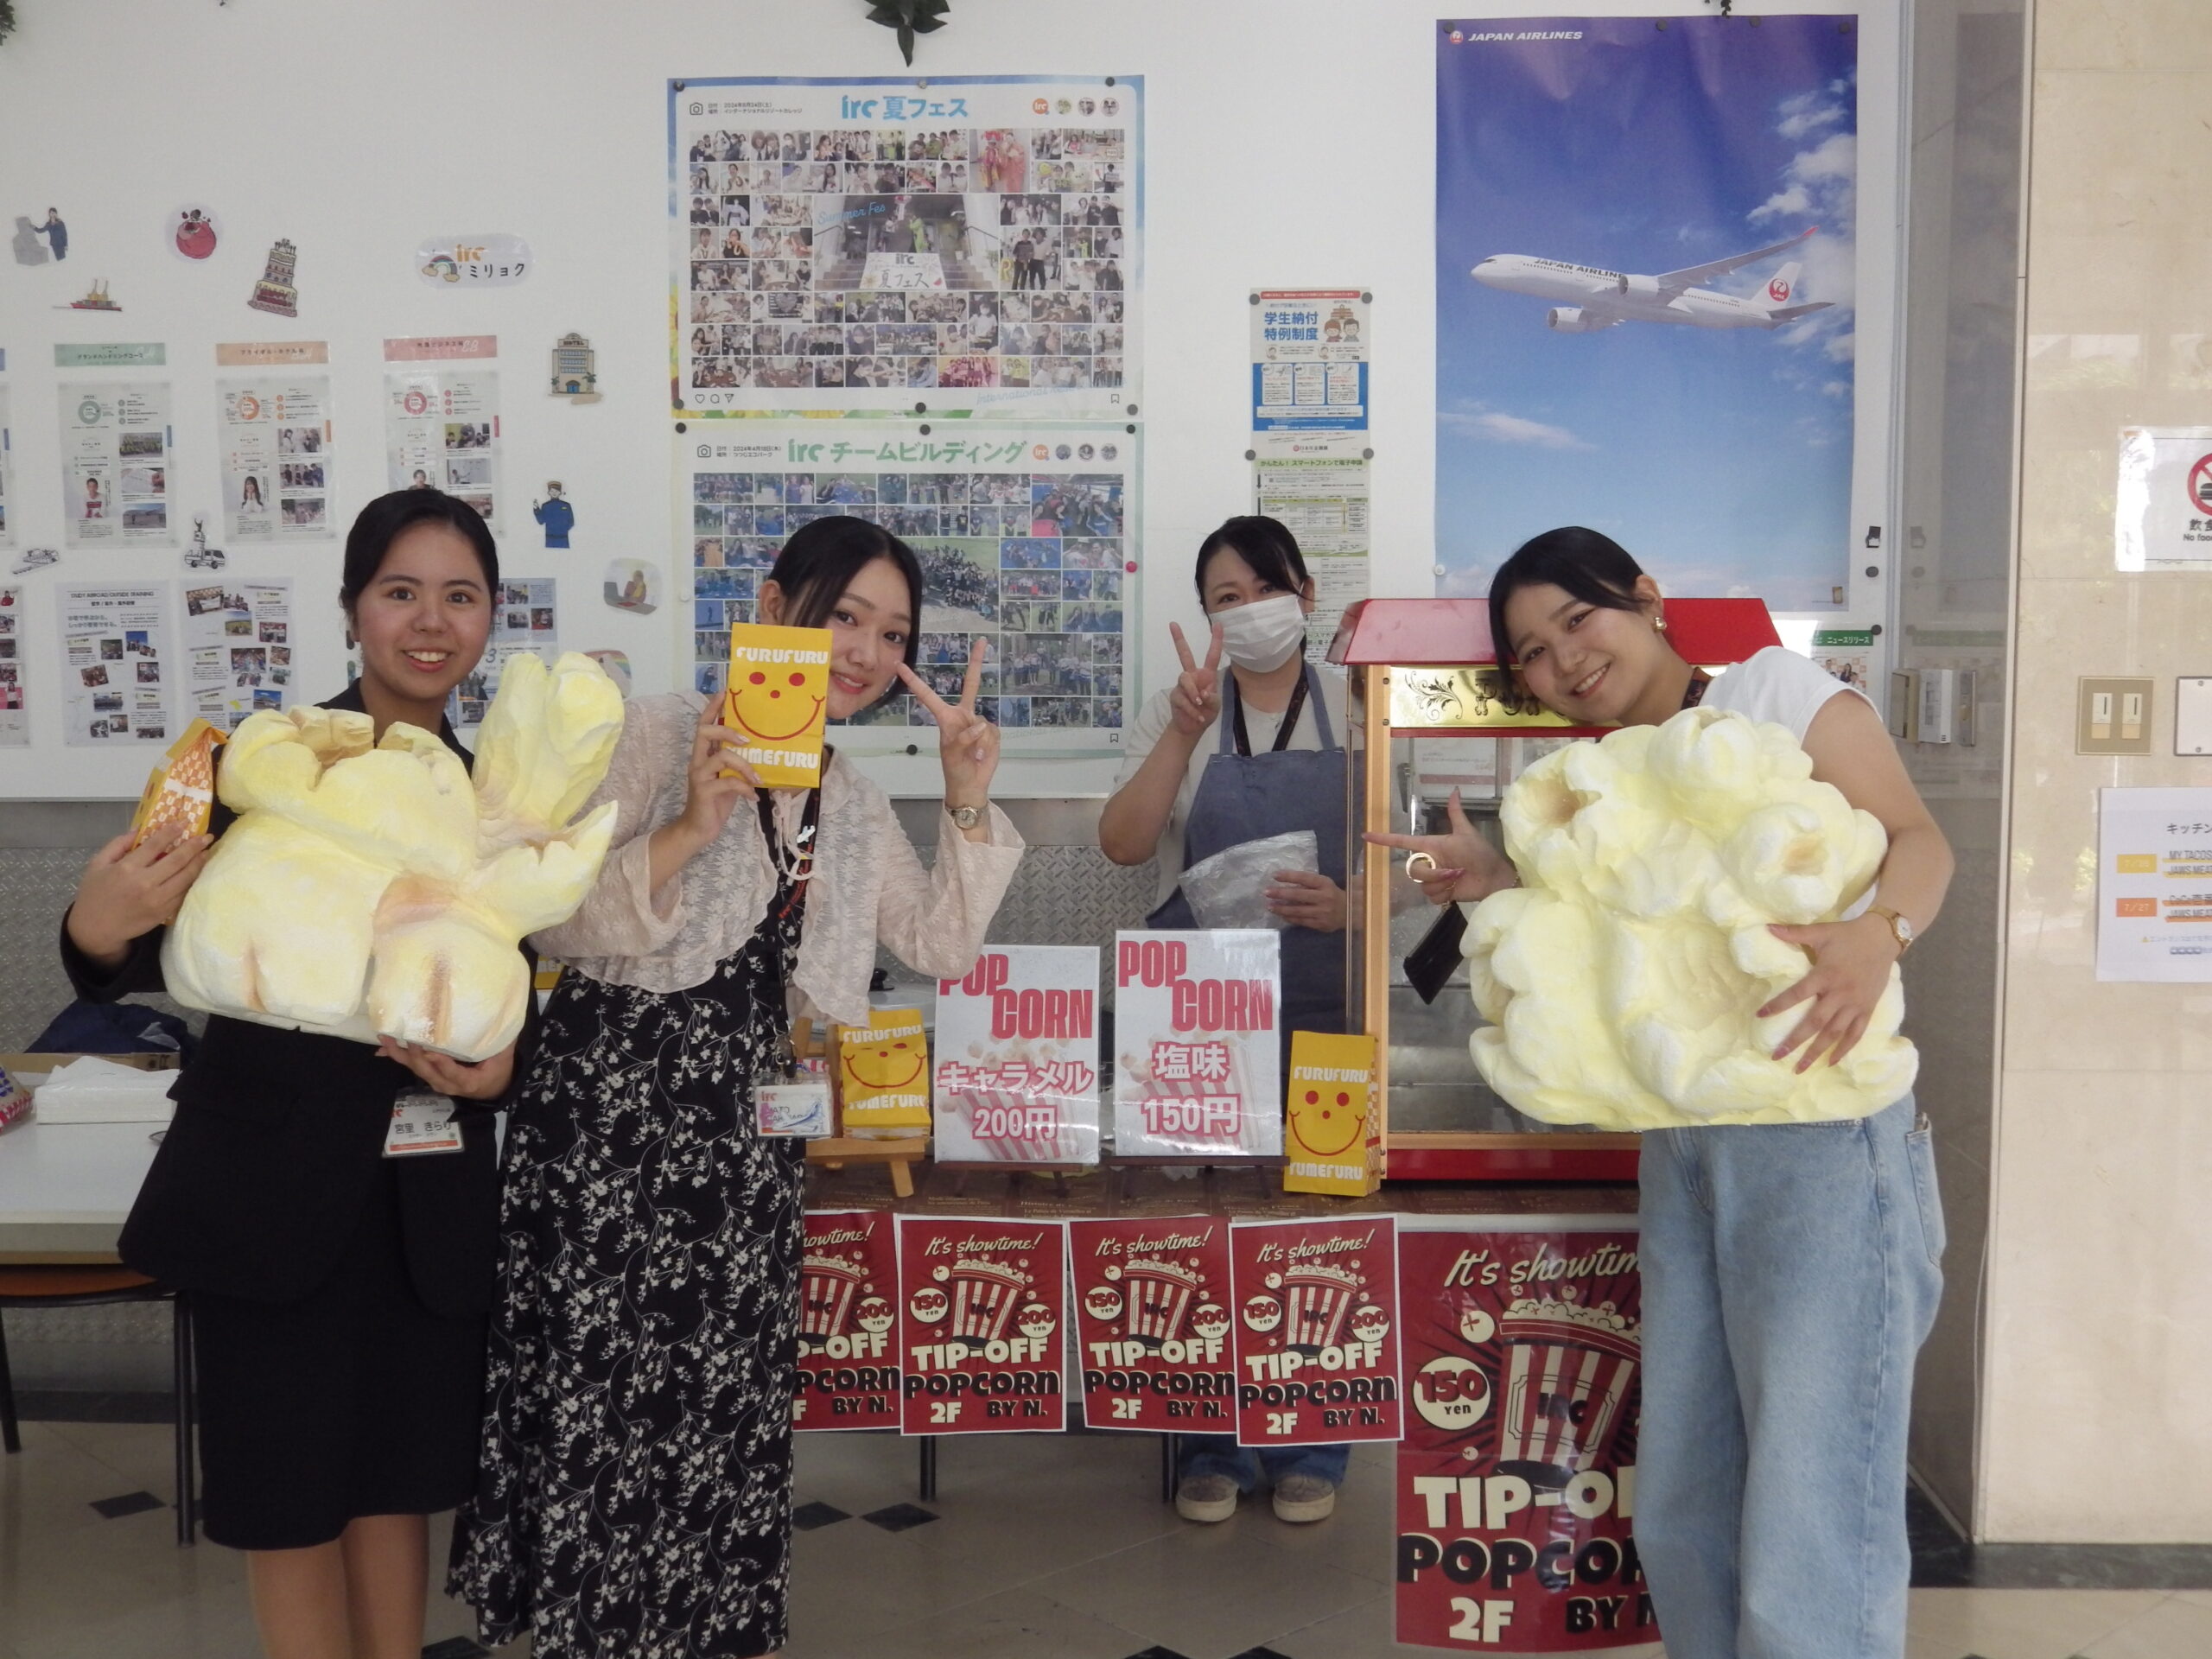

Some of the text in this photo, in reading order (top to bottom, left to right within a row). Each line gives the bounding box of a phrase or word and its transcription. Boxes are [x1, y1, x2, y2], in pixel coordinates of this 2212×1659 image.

[1516, 31, 1583, 40] AIRLINES
[842, 95, 969, 121] irc 夏フェス
[817, 201, 886, 225] Summer Fes
[456, 244, 485, 263] irc
[1534, 257, 1573, 270] JAPAN
[469, 263, 524, 278] ミリョク
[879, 270, 930, 289] 夏フェス
[1264, 312, 1319, 325] 学生納付
[1264, 327, 1319, 340] 特例制度
[788, 439, 1027, 463] irc チームビルディング
[736, 646, 828, 664] FURUFURU
[1118, 940, 1187, 988] POP
[991, 988, 1093, 1039] CORN
[1172, 978, 1273, 1032] CORN
[842, 1024, 922, 1044] FURUFURU
[1152, 1041, 1231, 1082] 塩味
[938, 1060, 1095, 1095] キャラメル
[1294, 1065, 1369, 1084] FURUFURU
[973, 1105, 1058, 1141] 200円
[1141, 1094, 1241, 1136] 150円
[1289, 1162, 1363, 1180] YUMEFURU
[804, 1221, 875, 1248] howtime!
[925, 1232, 1044, 1256] It's showtime!
[1095, 1225, 1213, 1256] It's showtime!
[1256, 1229, 1375, 1262] It's showtime!
[1444, 1243, 1641, 1287] It's showtim
[855, 1302, 893, 1320] 200
[912, 1294, 946, 1311] 150
[1086, 1292, 1121, 1308] 150
[1245, 1301, 1280, 1319] 150
[1016, 1308, 1056, 1325] 200
[1192, 1308, 1230, 1325] 200
[1349, 1311, 1389, 1329] 200
[912, 1338, 1048, 1371] TIP-OFF
[1089, 1338, 1224, 1367] TIP-OFF
[1246, 1342, 1382, 1381] TIP-OFF
[795, 1366, 899, 1395] PCORN
[904, 1370, 1061, 1400] POPCORN
[1084, 1370, 1235, 1395] POPCORN
[1416, 1370, 1488, 1403] 150
[1239, 1376, 1396, 1408] POPCORN
[792, 1400, 806, 1421] F
[832, 1395, 893, 1414] BY N.
[930, 1402, 962, 1423] 2F
[987, 1399, 1048, 1417] BY N.
[1111, 1398, 1142, 1420] 2F
[1167, 1400, 1227, 1417] BY N.
[1444, 1404, 1471, 1415] Yen
[1266, 1413, 1298, 1434] 2F
[1323, 1407, 1384, 1427] BY N.
[1414, 1465, 1635, 1529] TIP-O
[1449, 1597, 1514, 1642] 2F
[1565, 1595, 1627, 1632] BY
